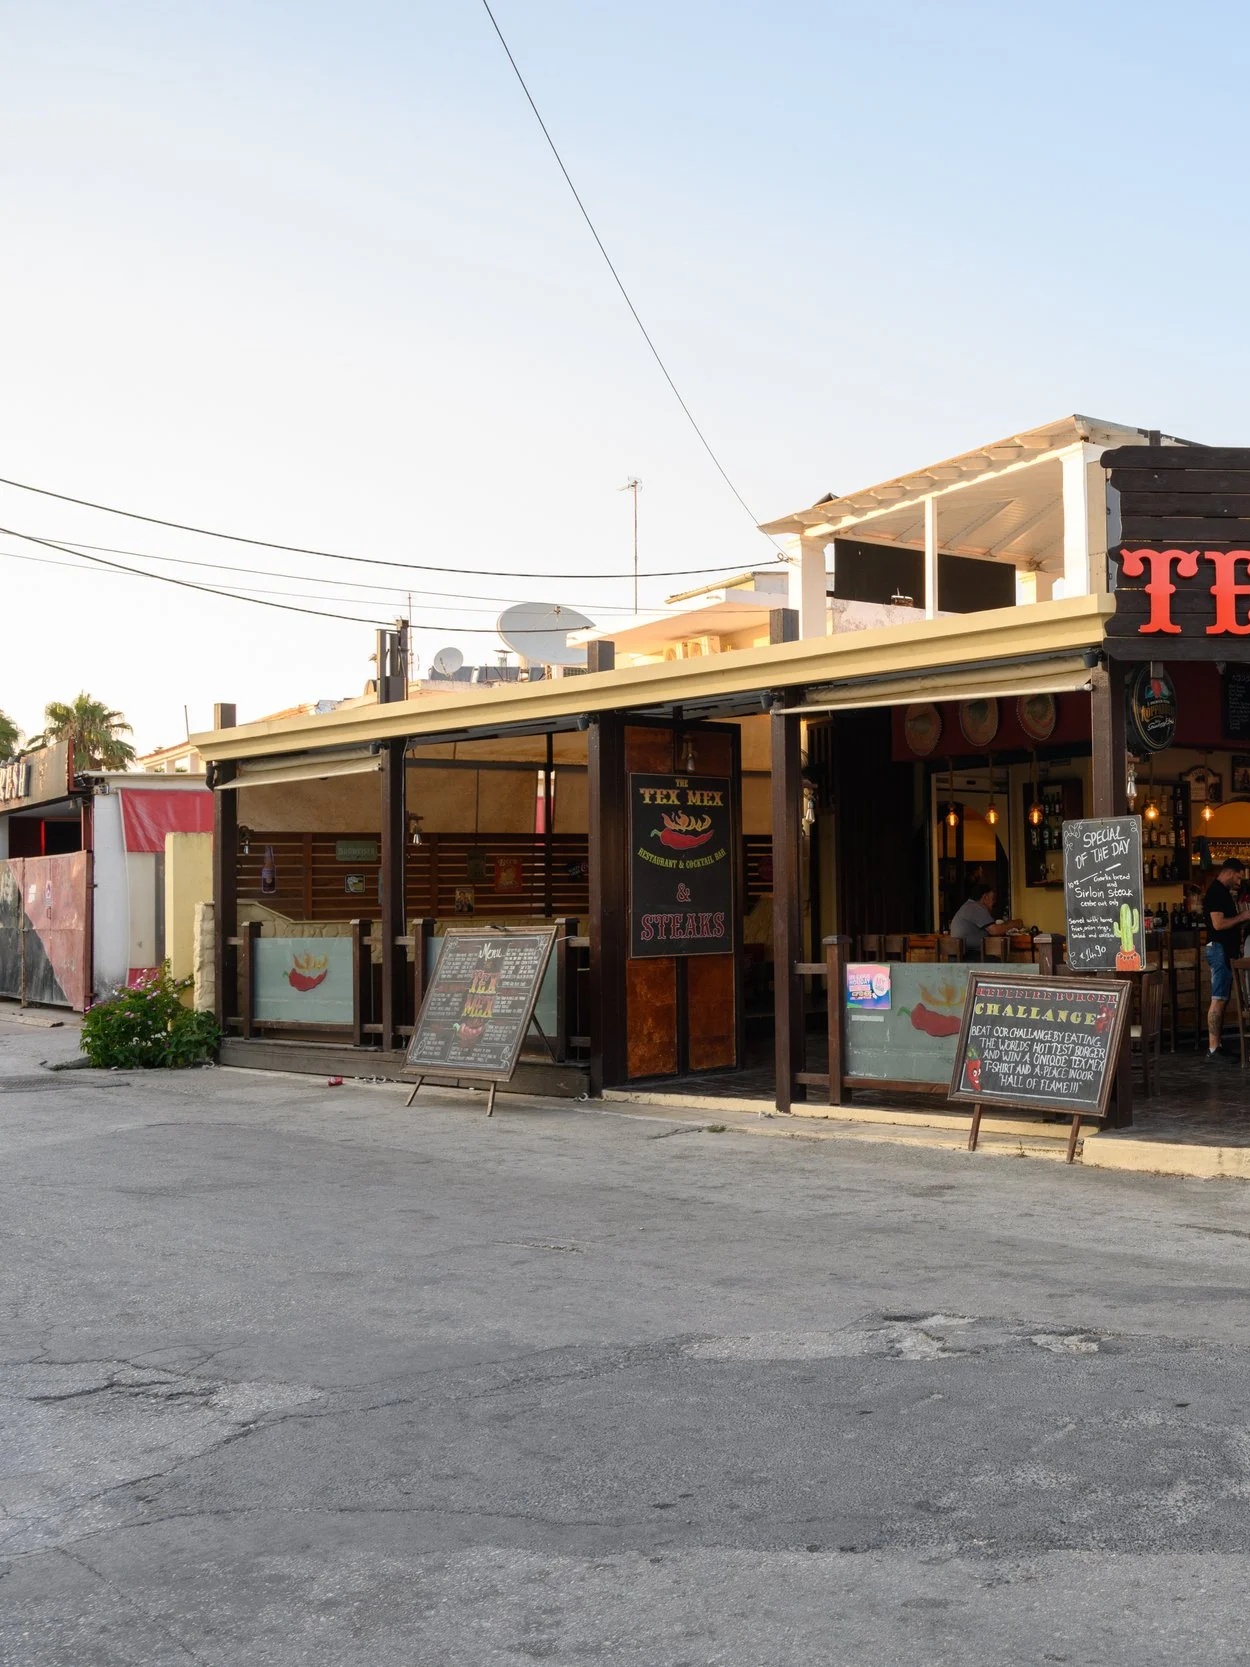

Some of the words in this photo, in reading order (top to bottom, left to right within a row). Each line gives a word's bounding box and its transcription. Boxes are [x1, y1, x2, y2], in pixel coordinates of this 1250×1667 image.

[675, 778, 688, 788] THE
[639, 787, 681, 805] TEX
[687, 789, 724, 806] MEX
[637, 848, 678, 869] RESTAURANT
[678, 859, 684, 869] &
[685, 854, 714, 869] COCKTAIL
[714, 848, 728, 861] BAR
[1075, 853, 1088, 869] OF
[1090, 847, 1109, 863] THE
[1111, 839, 1131, 855] DAY
[676, 882, 691, 902] &
[1074, 886, 1104, 898] Sirloin
[640, 911, 725, 940] STEAKS
[468, 969, 500, 994] TEX
[462, 993, 497, 1018] MEX
[976, 987, 1052, 1000] HELLFIRE
[1056, 992, 1118, 1004] BURGER
[975, 1003, 1097, 1025] CHALLANGE
[971, 1025, 991, 1036] BEAT
[1053, 1031, 1065, 1041] BY
[1064, 1032, 1101, 1047] EATING
[979, 1038, 996, 1048] THE
[999, 1038, 1030, 1051] WORLDS
[982, 1049, 1000, 1059] AND
[1002, 1051, 1020, 1062] WIN
[1023, 1053, 1031, 1063] A
[1070, 1056, 1086, 1069] TEX
[1087, 1058, 1105, 1072] MEX
[984, 1060, 1015, 1074] T-SHIRT
[1015, 1063, 1031, 1075] AND
[1068, 1067, 1075, 1079] IN
[1026, 1078, 1037, 1089] OF
